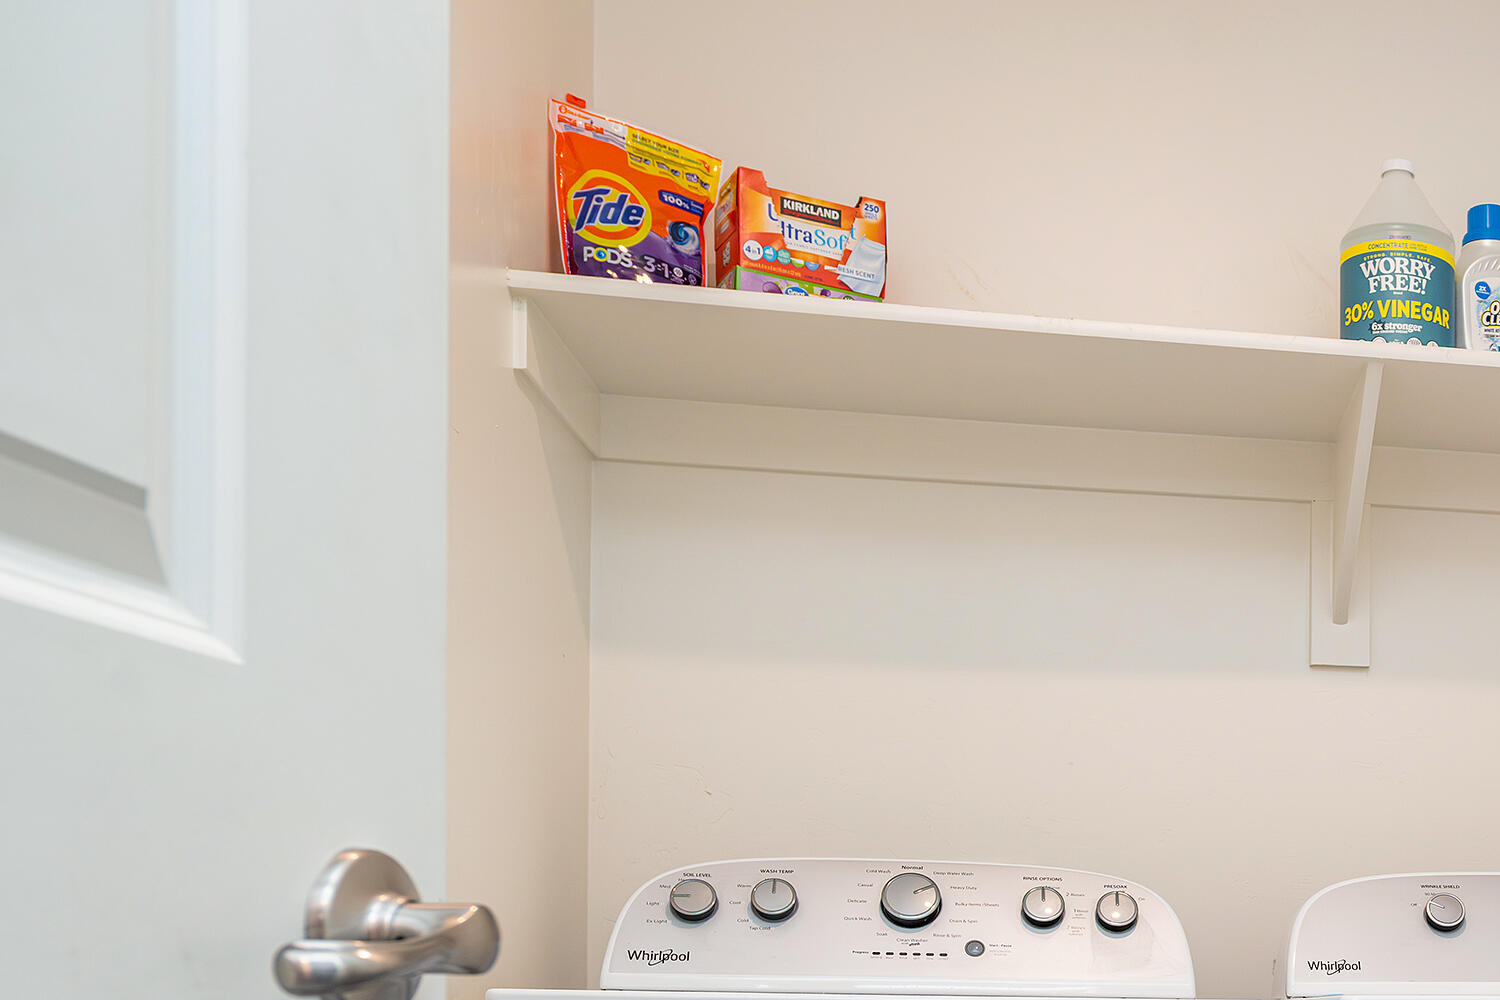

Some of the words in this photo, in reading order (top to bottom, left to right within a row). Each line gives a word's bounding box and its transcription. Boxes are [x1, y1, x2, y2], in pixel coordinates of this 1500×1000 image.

[572, 187, 646, 233] Tide
[661, 193, 690, 210] 100%
[783, 199, 840, 220] KIRKLAND
[864, 203, 880, 214] 250
[745, 245, 751, 254] 4
[1368, 242, 1408, 250] CONCENTRATE
[583, 246, 633, 268] PODS
[855, 270, 875, 280] SCENT
[1360, 257, 1436, 280] WORRY
[1368, 274, 1428, 295] FREE!
[1344, 300, 1374, 326] 30%
[1376, 300, 1450, 330] VINEGAR
[1371, 322, 1383, 331] 6x
[1383, 322, 1423, 333] stronger
[627, 949, 690, 966] Whirlpool
[1307, 959, 1361, 975] Whirlpool
